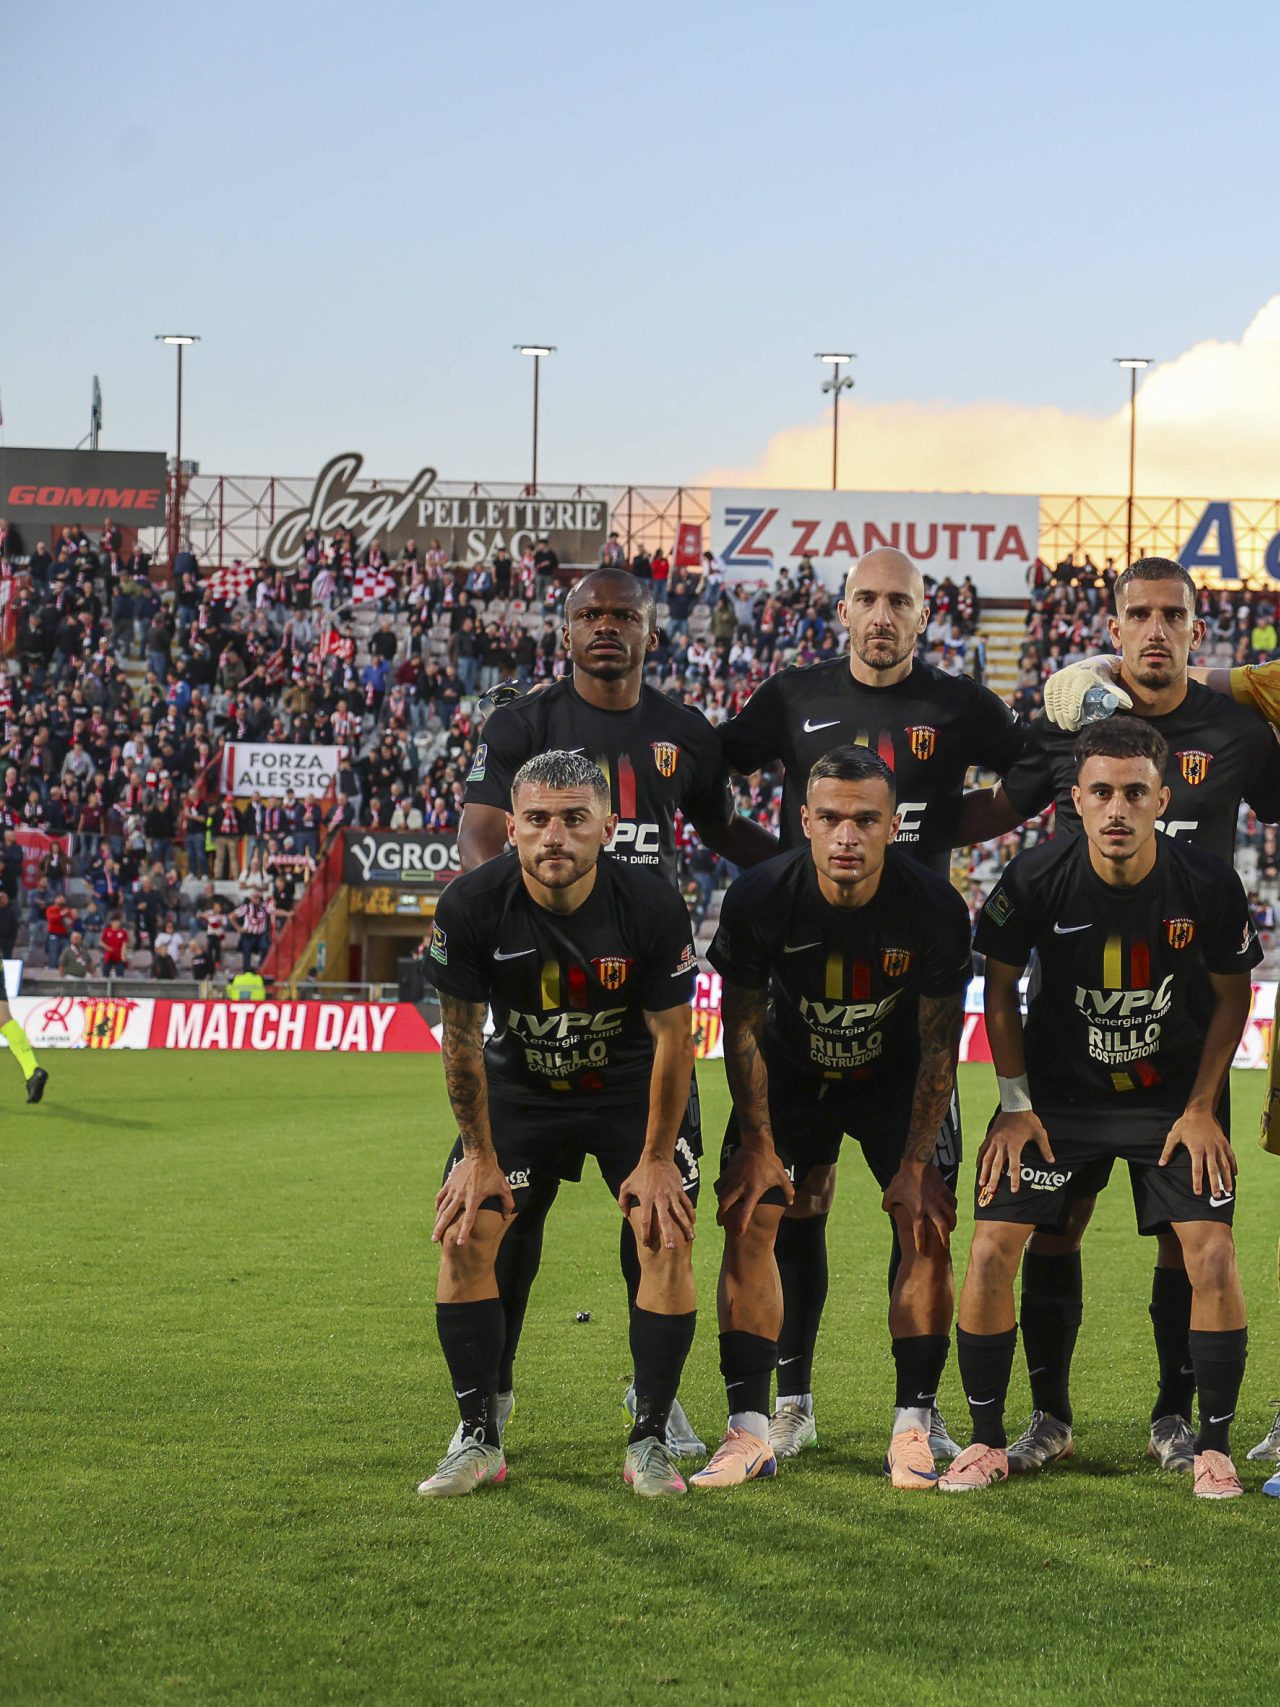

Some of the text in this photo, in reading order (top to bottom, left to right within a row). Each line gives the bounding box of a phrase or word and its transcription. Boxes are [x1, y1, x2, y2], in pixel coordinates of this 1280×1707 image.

[8, 485, 161, 510] GOMME
[417, 500, 602, 531] PELLETTERIE
[789, 519, 1029, 562] ZANUTTA
[249, 752, 323, 770] FORZA
[238, 771, 334, 788] ALESSIO
[603, 822, 660, 852] PC
[894, 832, 920, 843] ulita
[1074, 973, 1175, 1016] IVPC
[165, 1002, 396, 1052] MATCH DAY
[508, 1006, 628, 1039] IVPC
[1094, 1016, 1143, 1028] energia
[810, 1031, 882, 1058] RILLO
[1088, 1022, 1162, 1052] RILLO
[525, 1040, 607, 1069] RILLO
[810, 1045, 882, 1068] COSTRUZIONI
[1088, 1040, 1160, 1065] COSTRUZIONI
[1018, 1162, 1073, 1188] ontel
